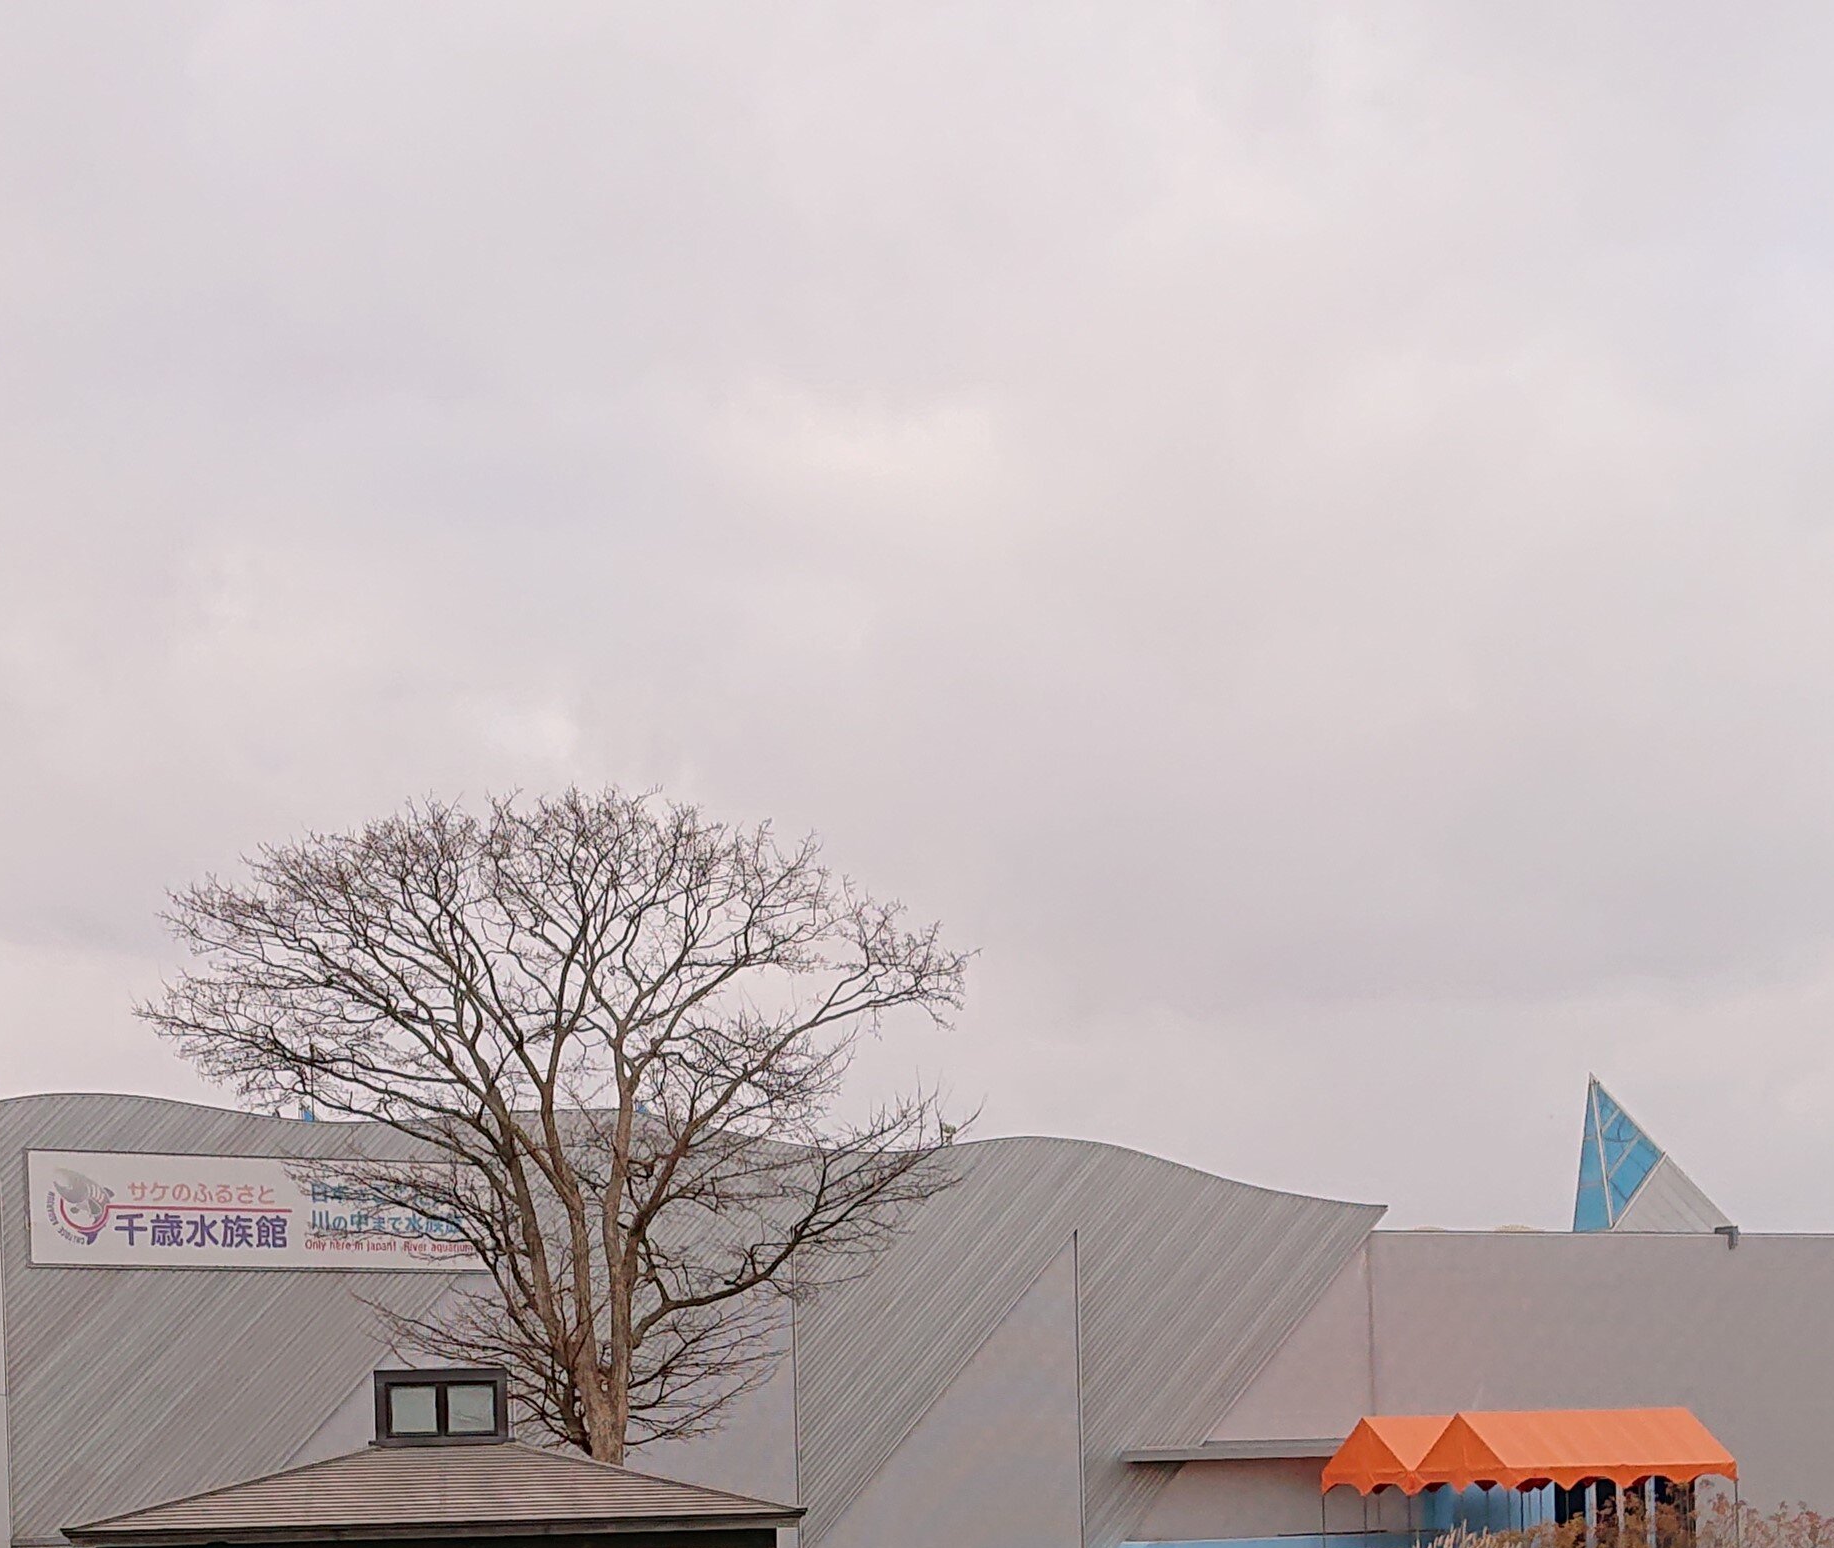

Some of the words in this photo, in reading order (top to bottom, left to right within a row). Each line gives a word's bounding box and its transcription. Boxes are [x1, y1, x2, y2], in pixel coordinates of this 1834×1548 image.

[127, 1183, 275, 1205] サケのふるさと
[115, 1213, 288, 1248] 千歳水族館
[305, 1239, 326, 1251] Only
[403, 1241, 427, 1251] River
[431, 1243, 473, 1254] aquarium
